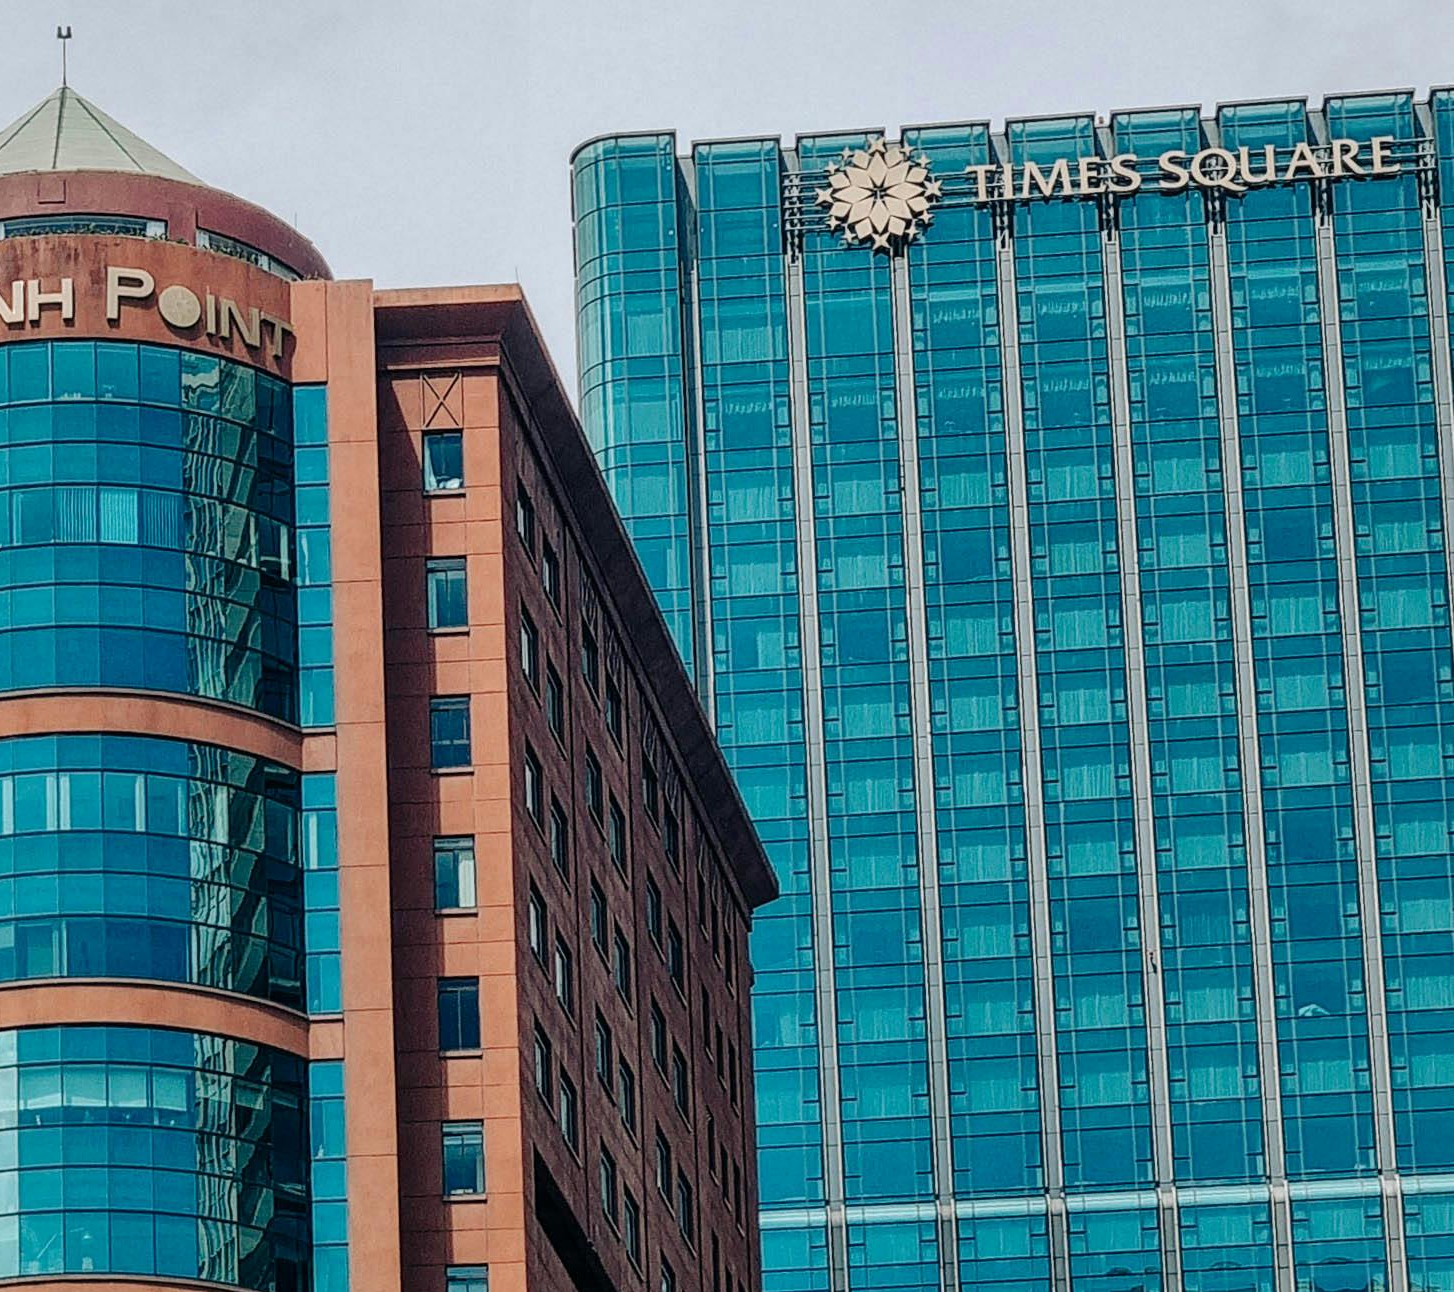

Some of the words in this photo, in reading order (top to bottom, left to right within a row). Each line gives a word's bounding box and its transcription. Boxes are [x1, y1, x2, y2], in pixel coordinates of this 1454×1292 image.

[964, 153, 1143, 203] TIMES
[1158, 135, 1402, 195] SQUARE
[105, 265, 296, 357] POINT
